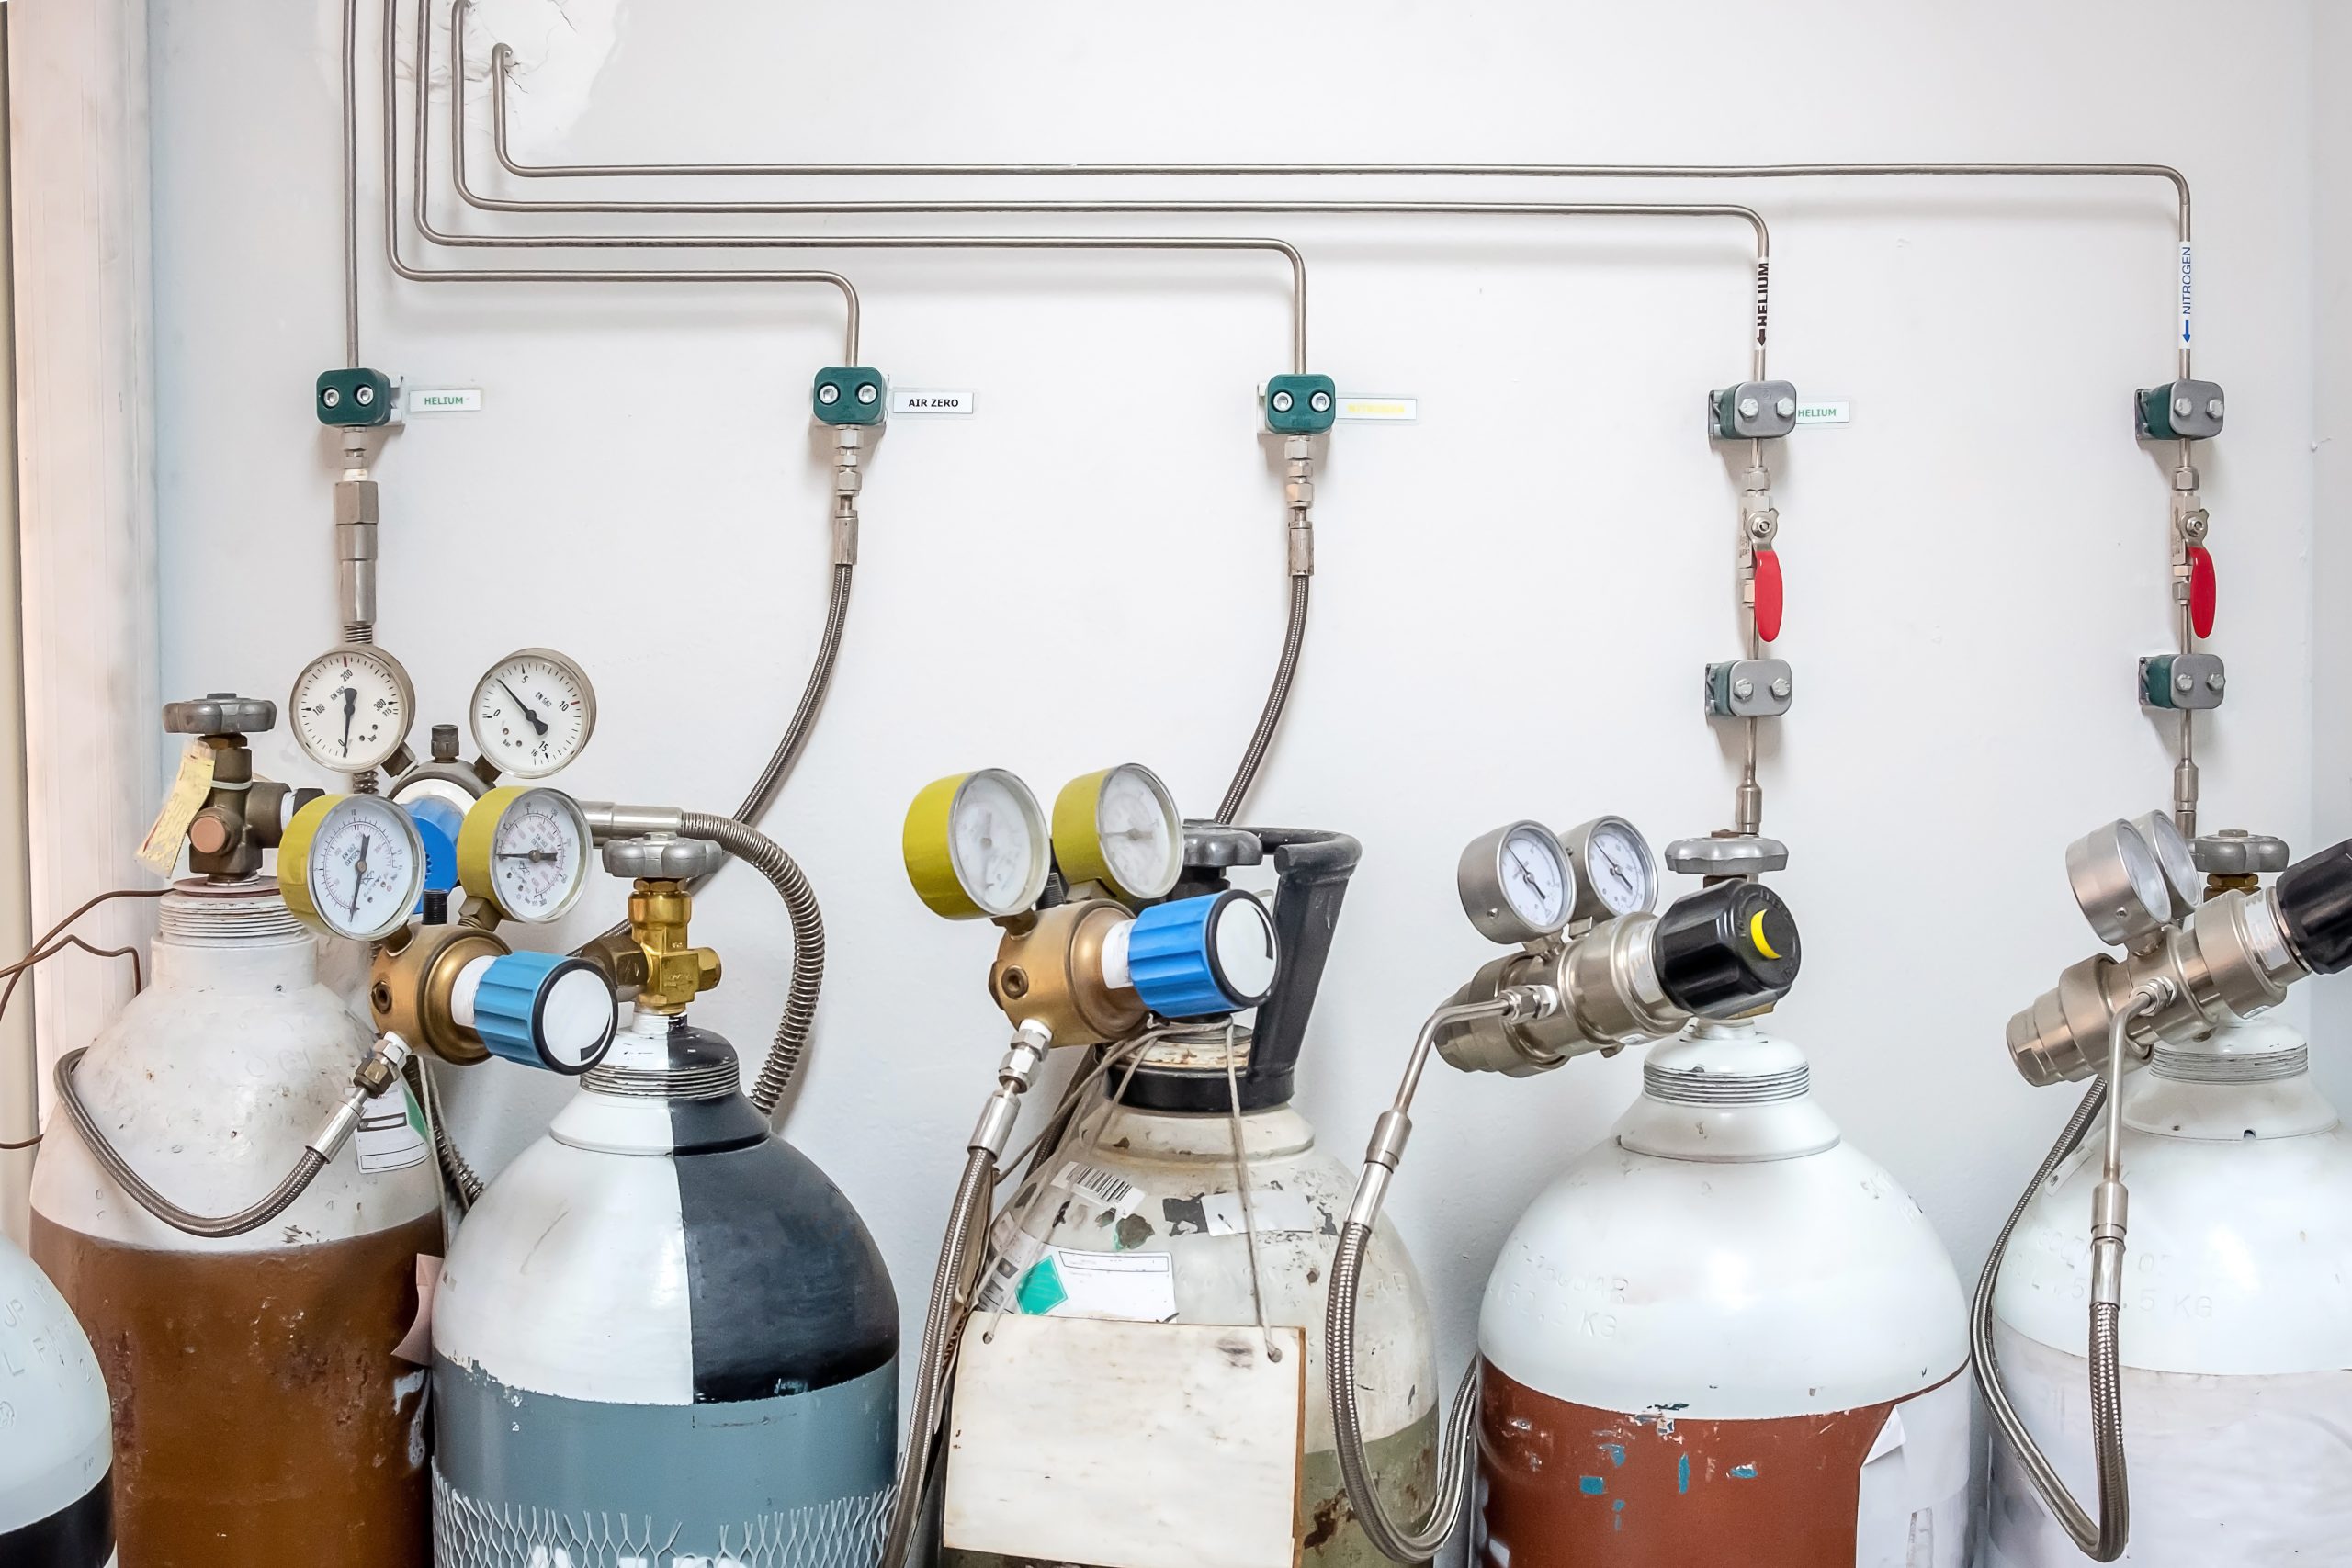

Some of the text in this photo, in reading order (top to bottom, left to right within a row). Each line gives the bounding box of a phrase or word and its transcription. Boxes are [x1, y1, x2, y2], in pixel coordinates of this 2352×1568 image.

[2181, 246, 2191, 315] NITROGEN
[1757, 262, 1769, 327] HELIUM
[424, 396, 464, 405] HELIUM
[908, 399, 959, 407] AIR ZERO
[1797, 408, 1837, 417] HELIUM
[340, 669, 353, 682] 200
[521, 675, 529, 684] 5
[330, 691, 338, 701] EN
[535, 691, 543, 700] EN
[373, 698, 387, 712] 300
[559, 700, 570, 712] 10
[312, 704, 325, 716] 100
[493, 709, 501, 717] 0
[338, 739, 345, 747] 0
[538, 740, 549, 752] 15
[342, 852, 349, 861] EN
